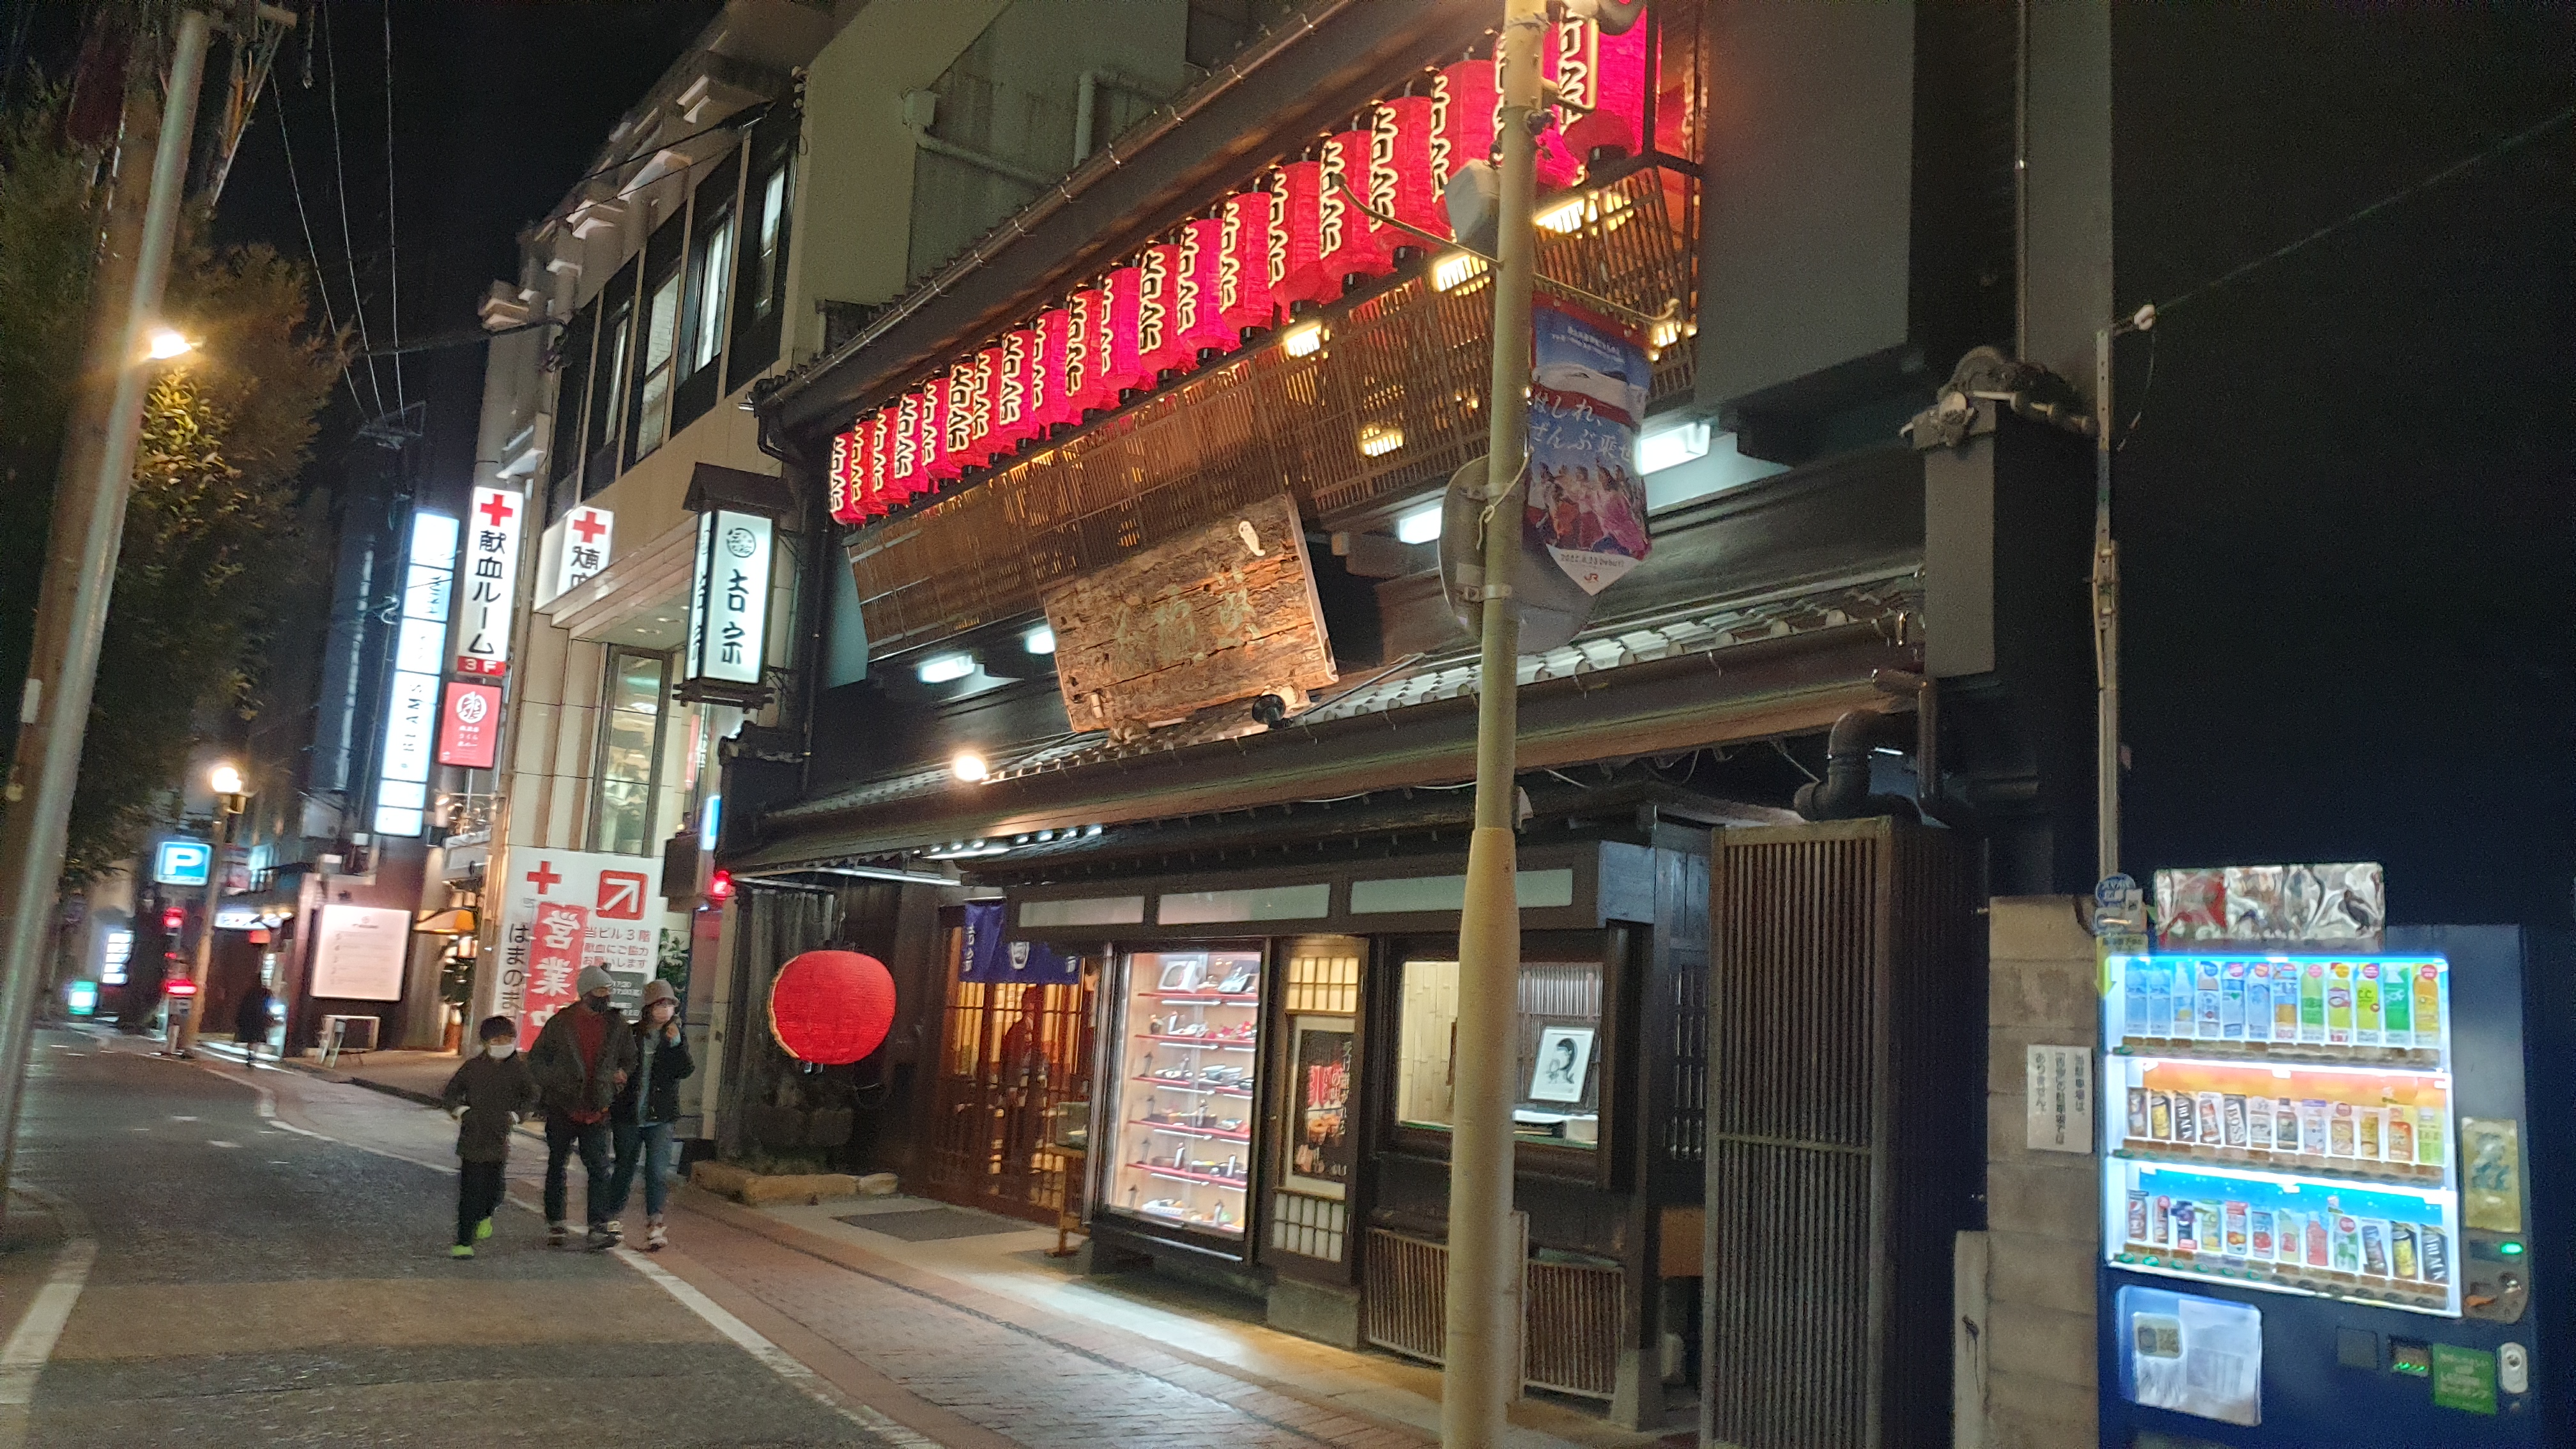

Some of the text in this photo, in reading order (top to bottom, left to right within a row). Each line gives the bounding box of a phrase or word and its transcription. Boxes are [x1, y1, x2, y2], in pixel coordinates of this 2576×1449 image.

[469, 530, 507, 654] 献血ルーム
[1584, 573, 1598, 583] JR
[721, 568, 749, 665] 吉宗
[464, 658, 497, 673] 3F
[164, 847, 204, 875] P
